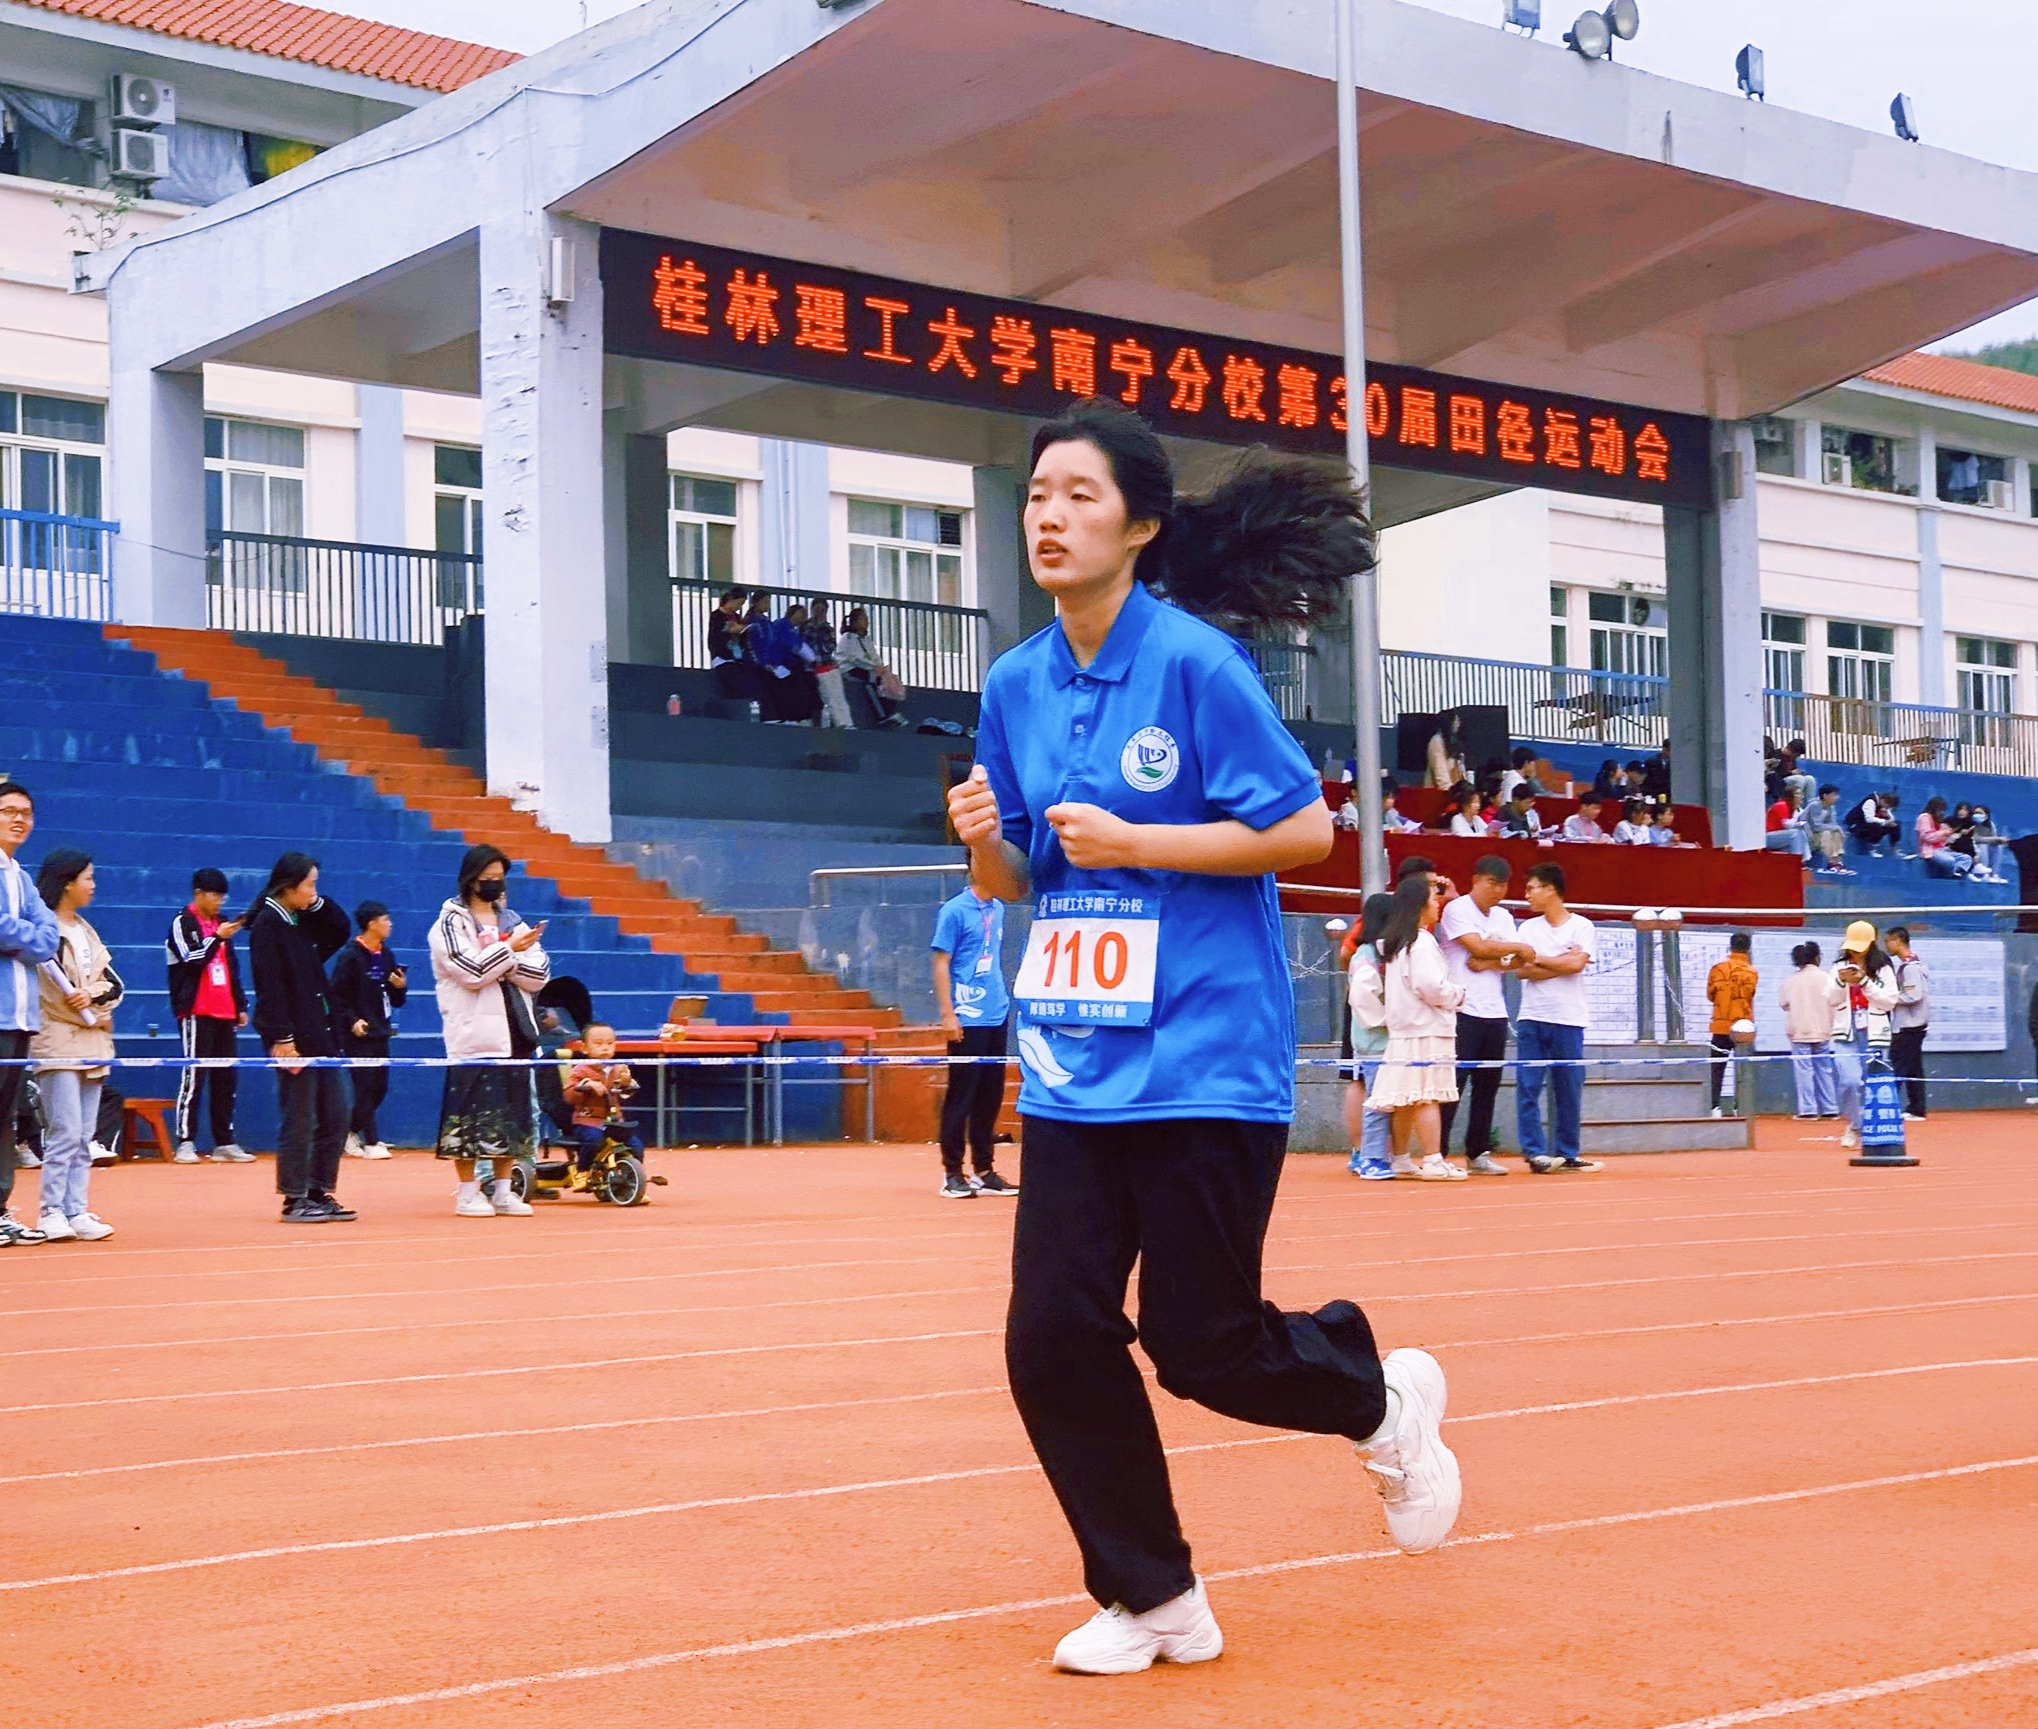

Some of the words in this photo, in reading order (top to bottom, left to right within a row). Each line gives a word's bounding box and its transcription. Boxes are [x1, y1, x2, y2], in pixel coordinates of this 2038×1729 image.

[653, 256, 1668, 481] 桂林理工大学南宁分校第30届田径运动会
[1043, 930, 1129, 990] 110
